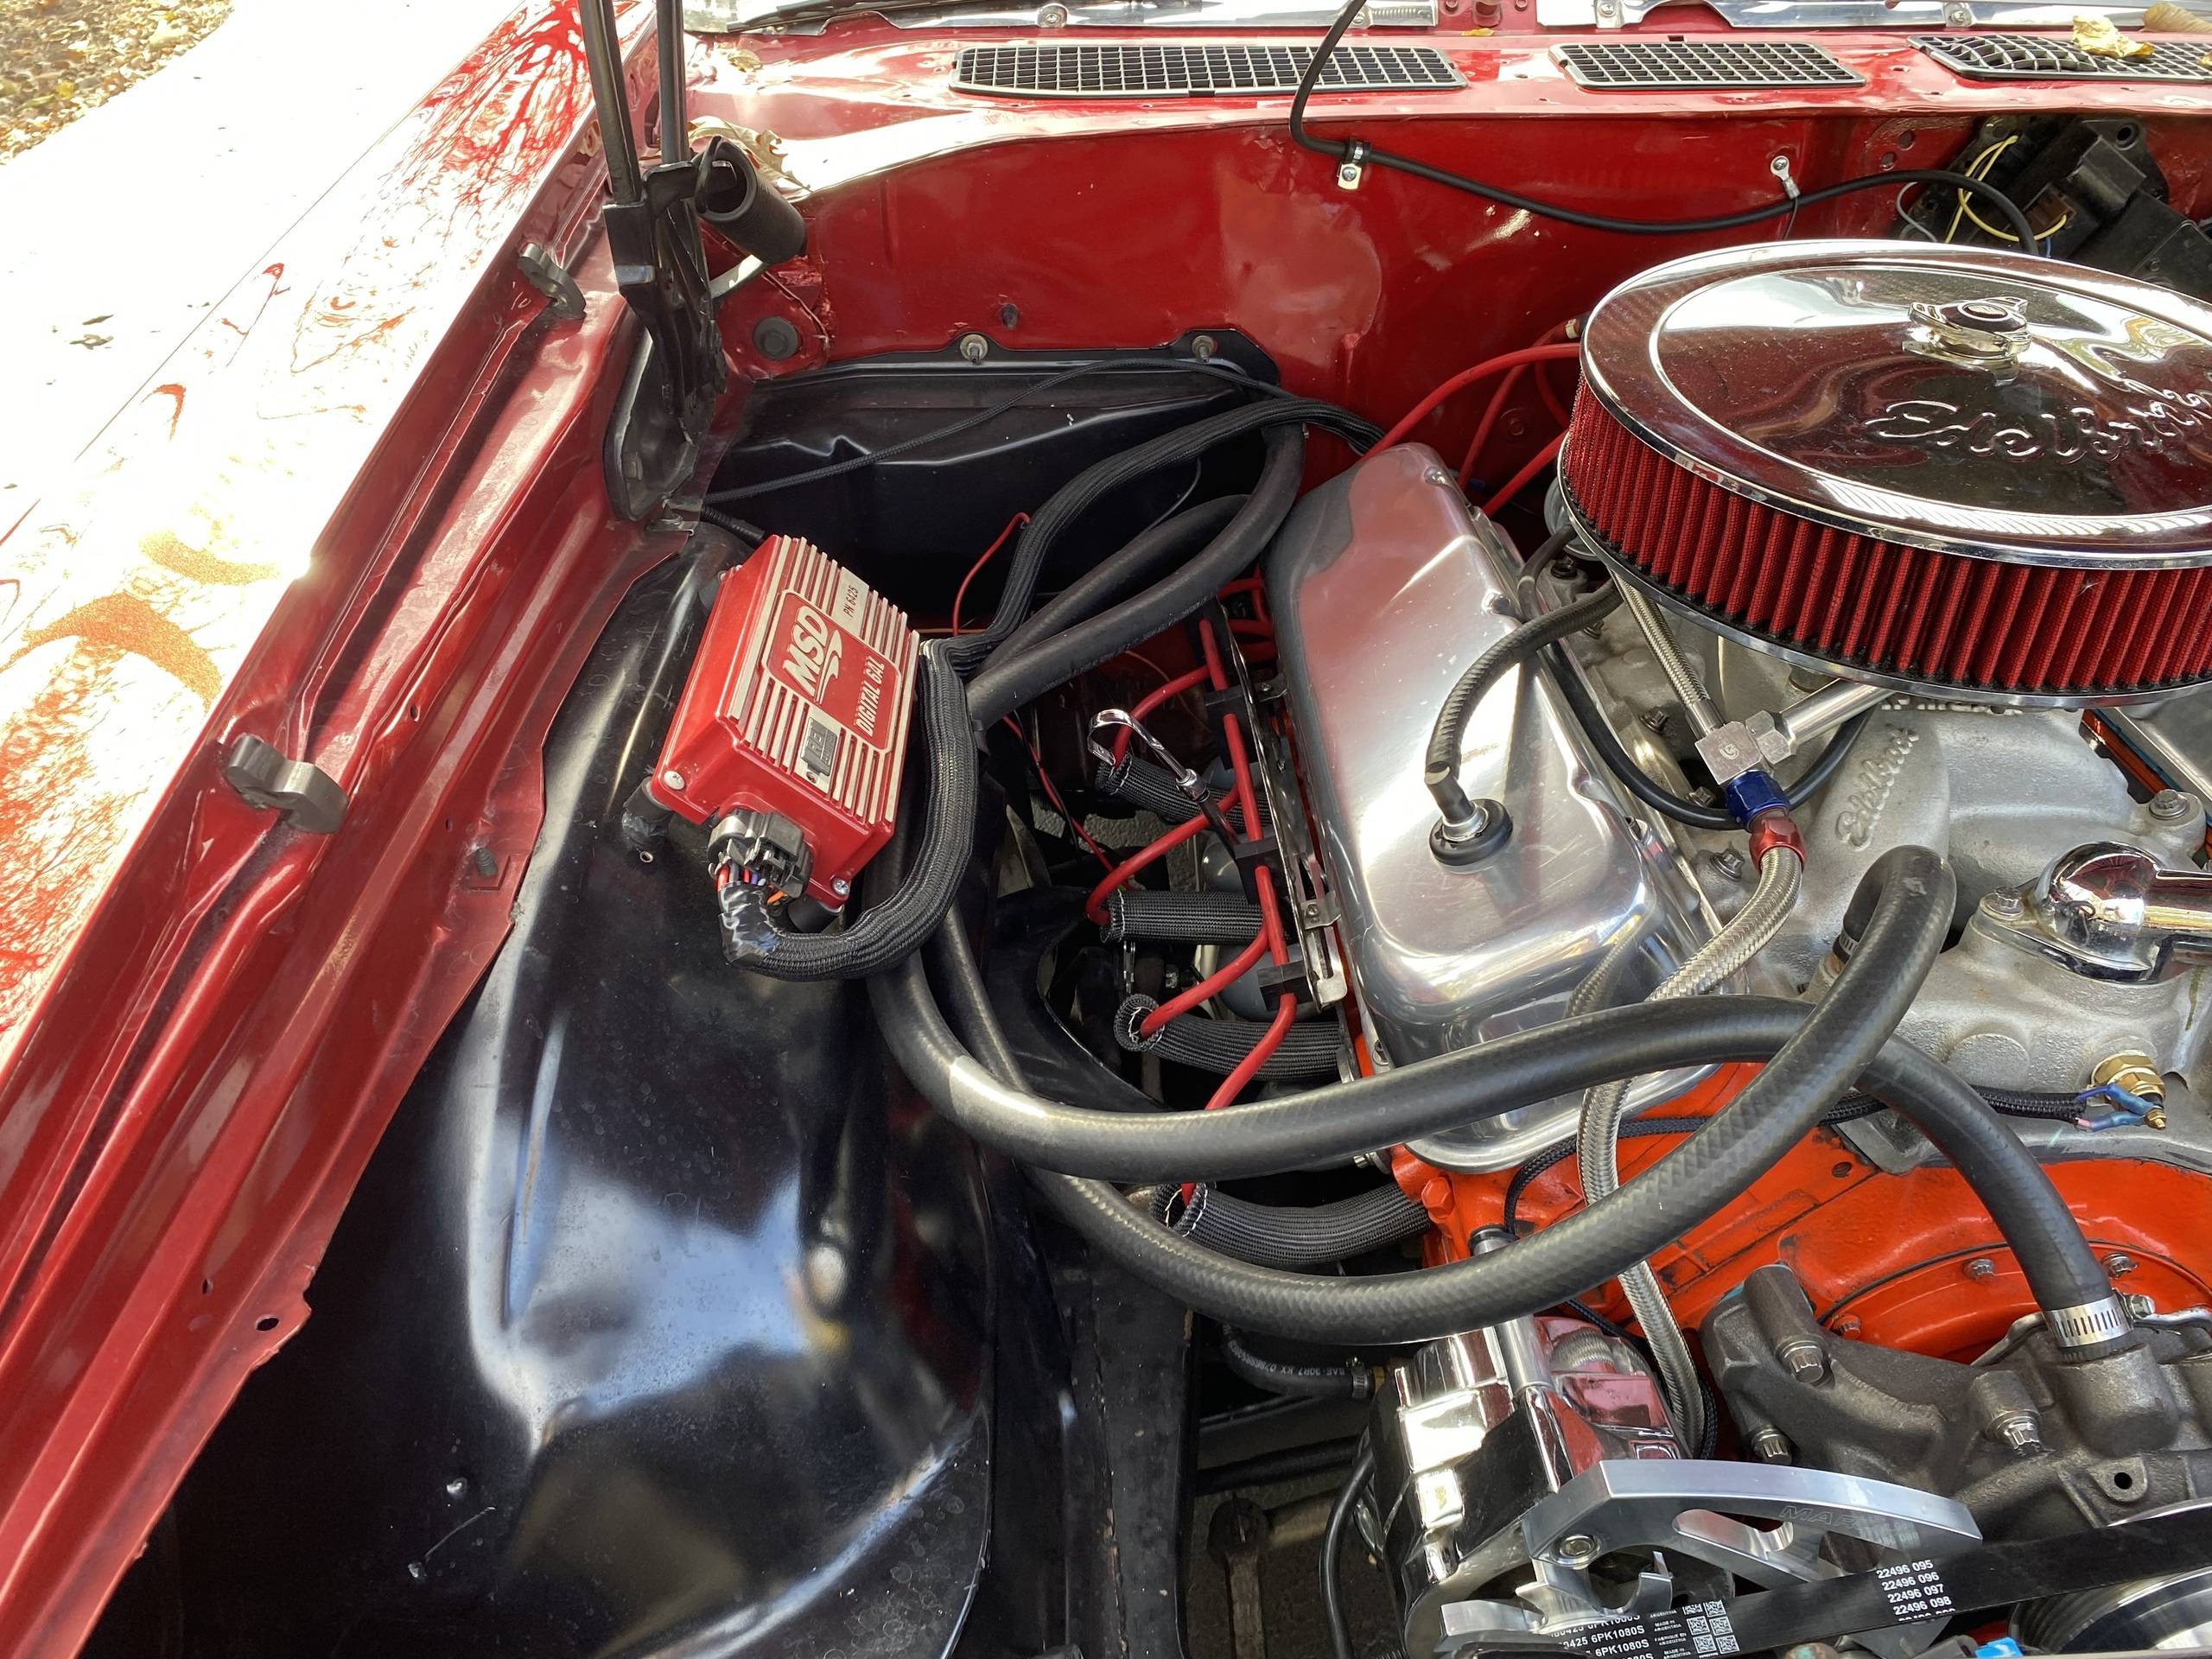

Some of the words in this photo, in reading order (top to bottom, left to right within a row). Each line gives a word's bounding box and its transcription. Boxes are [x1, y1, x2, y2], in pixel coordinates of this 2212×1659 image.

[848, 585, 859, 605] 6425
[782, 605, 829, 696] MSD
[866, 655, 885, 684] 6AL
[855, 680, 881, 737] DIGITAL
[1876, 1564, 1910, 1579] 22496
[1911, 1559, 1934, 1572] 095
[1881, 1576, 1916, 1591] 22496
[1917, 1572, 1940, 1584] 096
[1887, 1588, 1922, 1604] 22496
[1923, 1583, 1944, 1596] 097
[1893, 1600, 1928, 1616] 22496
[1929, 1596, 1952, 1608] 098
[1559, 1637, 1588, 1649] 0425
[1592, 1625, 1644, 1643] 6PK1080S
[1595, 1639, 1649, 1657] 6PK1080S
